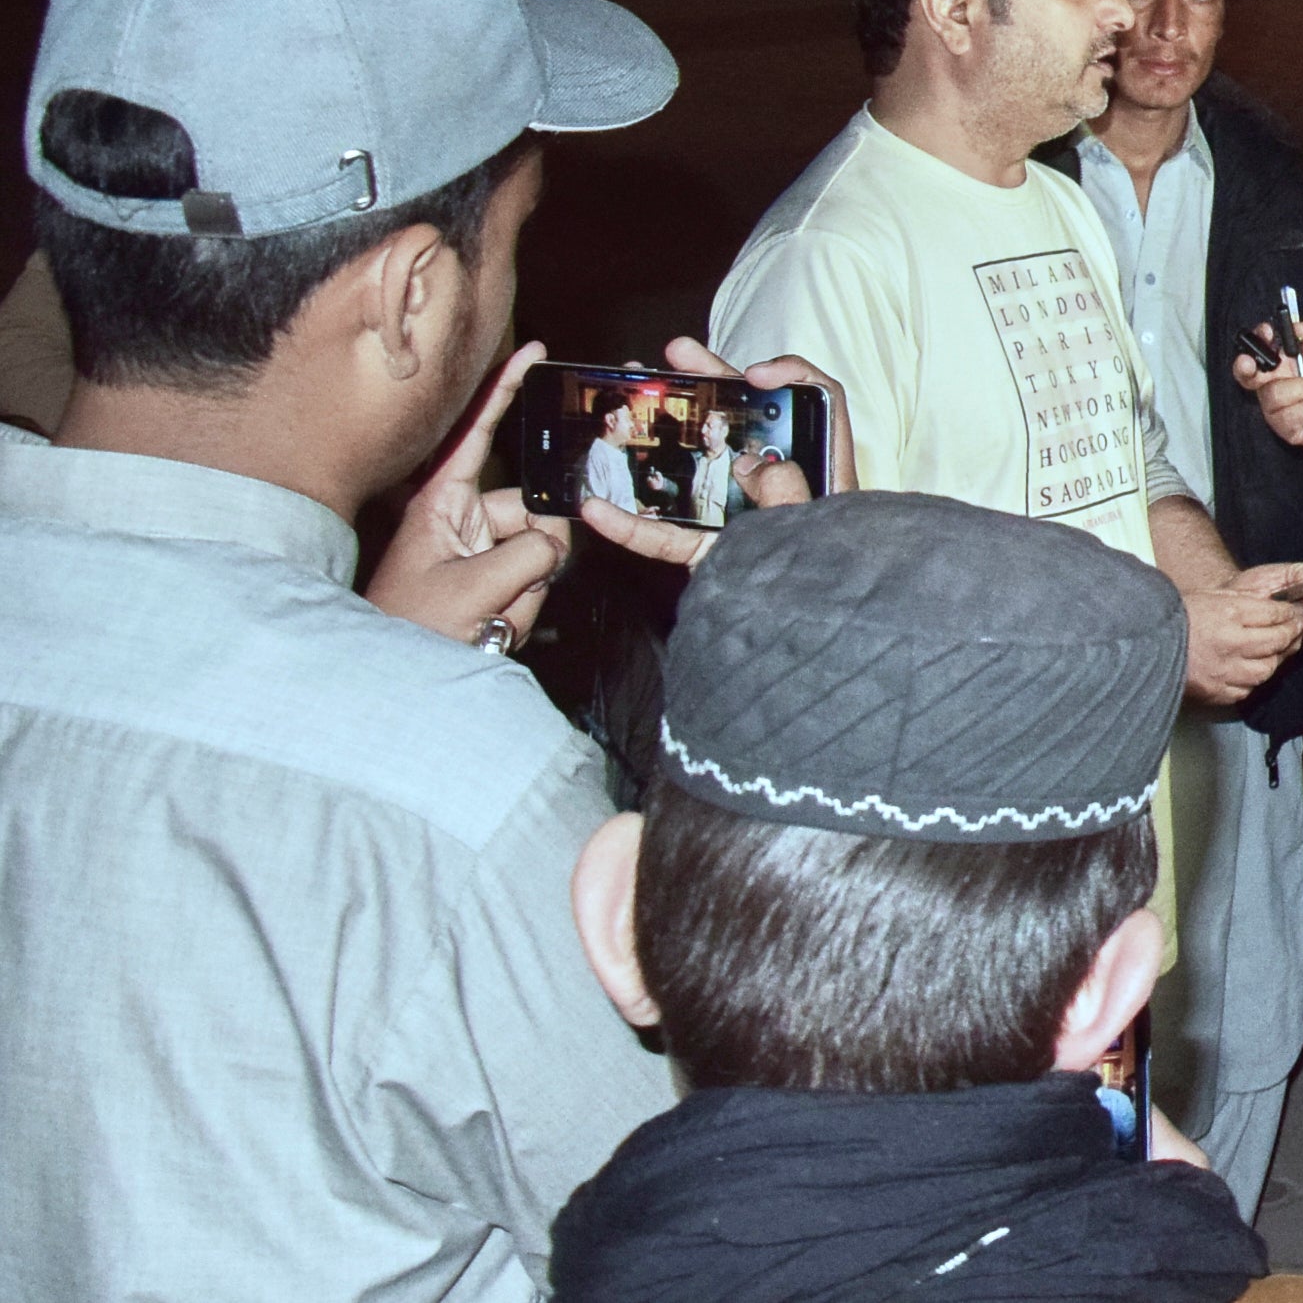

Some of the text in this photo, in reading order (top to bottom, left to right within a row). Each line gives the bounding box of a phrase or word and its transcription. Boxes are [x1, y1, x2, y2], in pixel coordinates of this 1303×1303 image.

[986, 259, 1091, 296] MILANO
[1000, 290, 1105, 328] LONDON
[1012, 322, 1114, 362] PARIS
[1025, 354, 1124, 395] TOKYO
